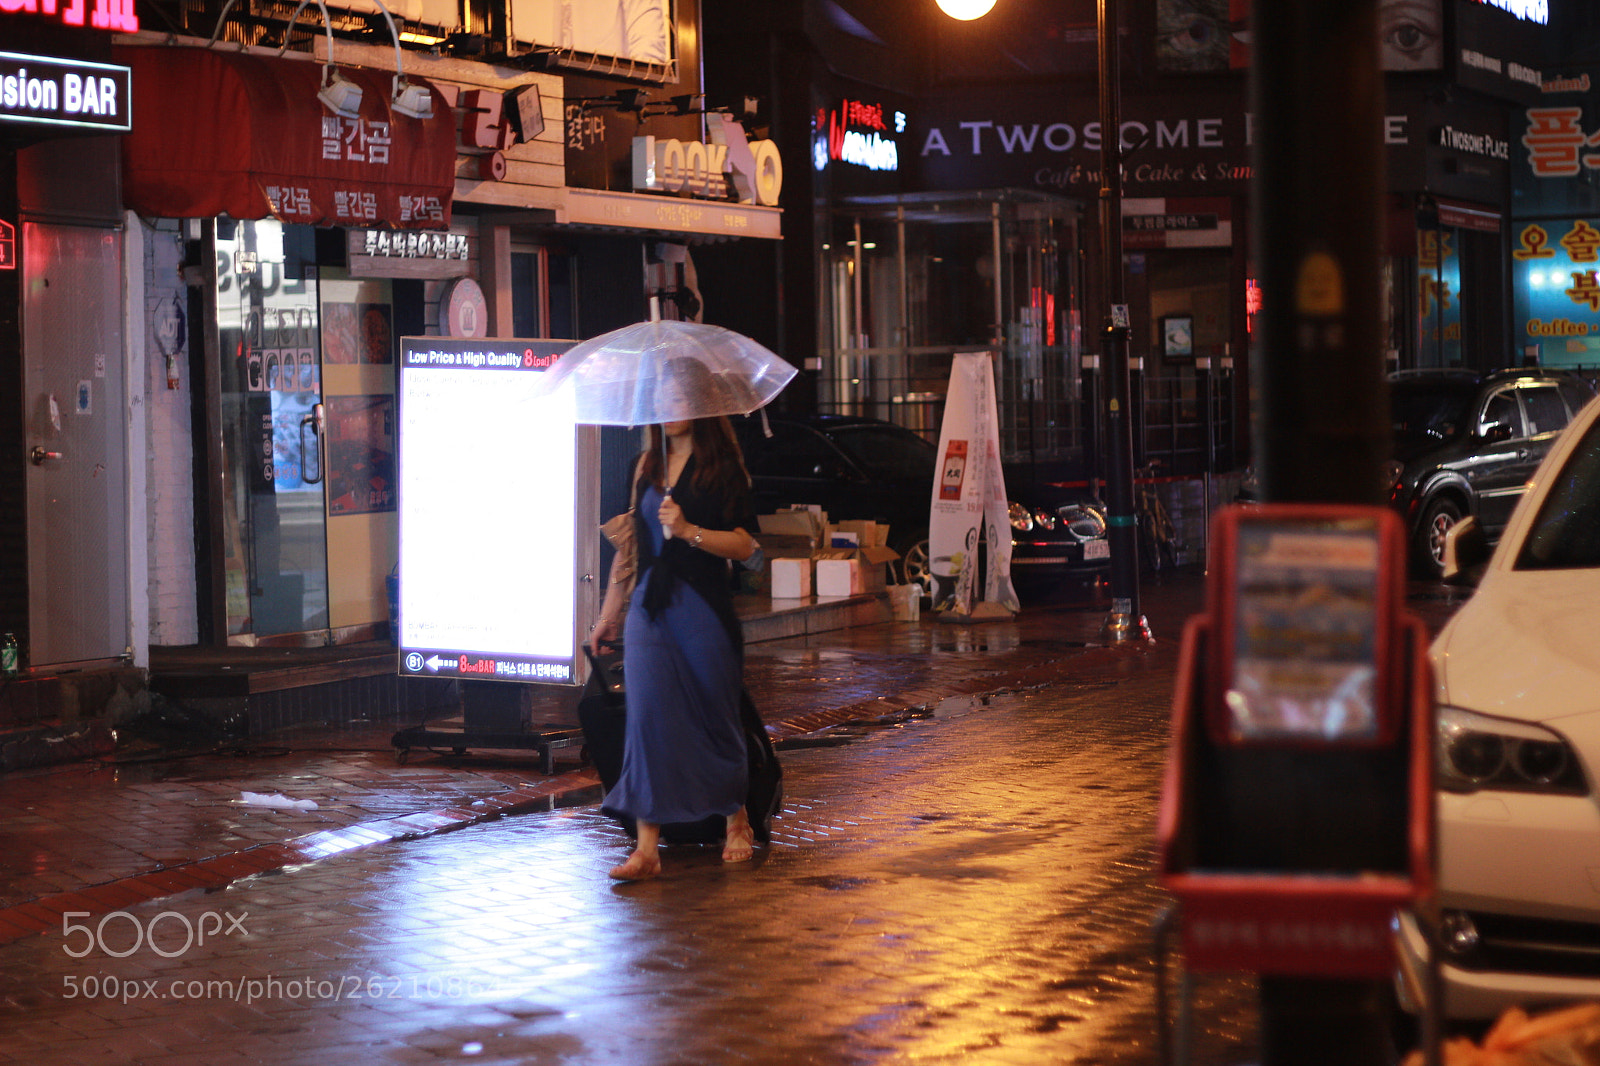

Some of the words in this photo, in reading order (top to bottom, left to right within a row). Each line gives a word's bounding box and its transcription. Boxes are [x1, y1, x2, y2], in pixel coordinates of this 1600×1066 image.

[0, 67, 58, 110] sion
[64, 73, 117, 116] BAR
[322, 115, 392, 164] 빨간곰
[921, 128, 951, 156] A
[959, 119, 1223, 155] TWOSOME
[1445, 125, 1485, 155] TWOSOME
[1485, 134, 1509, 160] PLACE
[634, 135, 729, 198] LOOK
[1033, 164, 1081, 189] Café
[1134, 163, 1184, 182] Cake
[1191, 163, 1207, 182] &
[266, 185, 312, 215] 빨간곰
[334, 190, 377, 220] 빨간곰
[398, 195, 445, 222] 빨간곰
[158, 317, 181, 338] ADT
[1526, 318, 1588, 336] Coffee
[409, 350, 428, 364] Low
[429, 351, 455, 365] Price
[456, 354, 463, 365] &
[463, 352, 486, 368] High
[487, 352, 522, 368] Quality
[409, 656, 422, 668] B1
